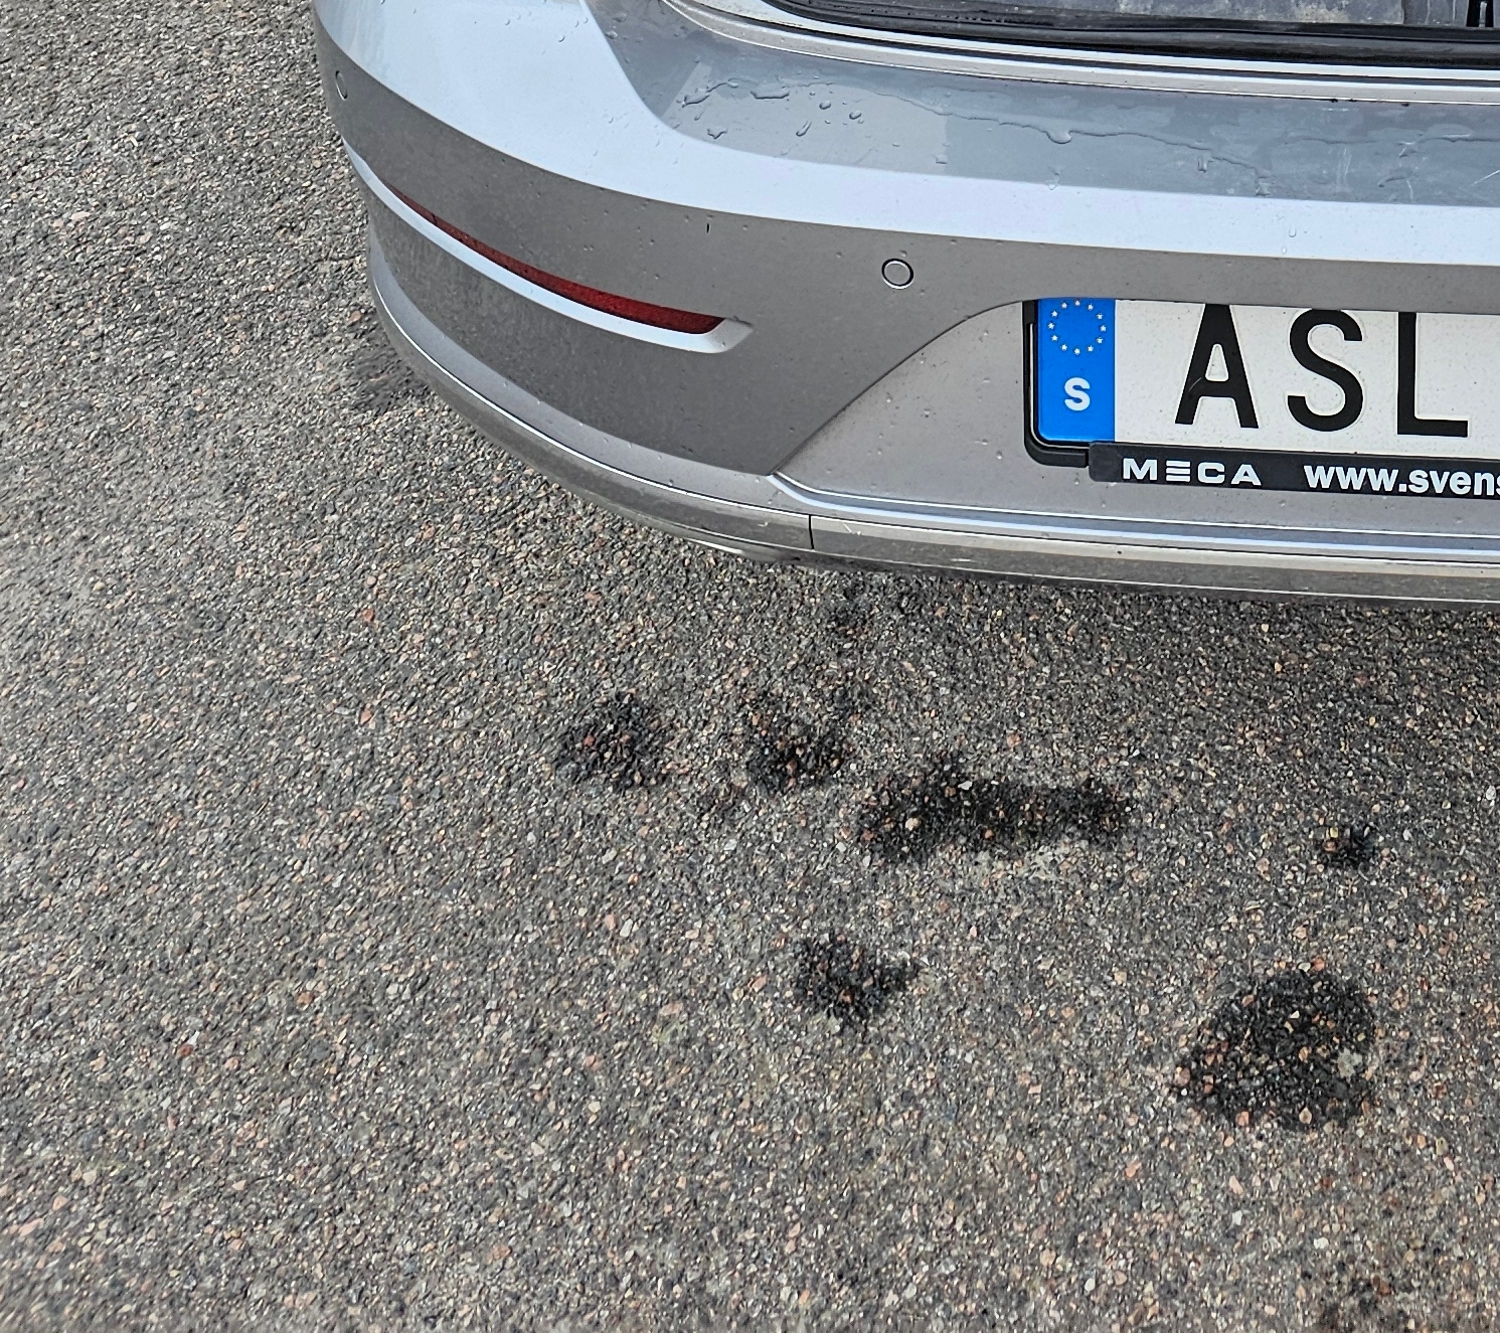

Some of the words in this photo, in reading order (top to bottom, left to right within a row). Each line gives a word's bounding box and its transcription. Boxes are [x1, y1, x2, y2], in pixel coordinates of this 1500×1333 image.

[1064, 376, 1091, 412] S
[1175, 303, 1468, 438] ASL
[1122, 458, 1263, 487] MECA
